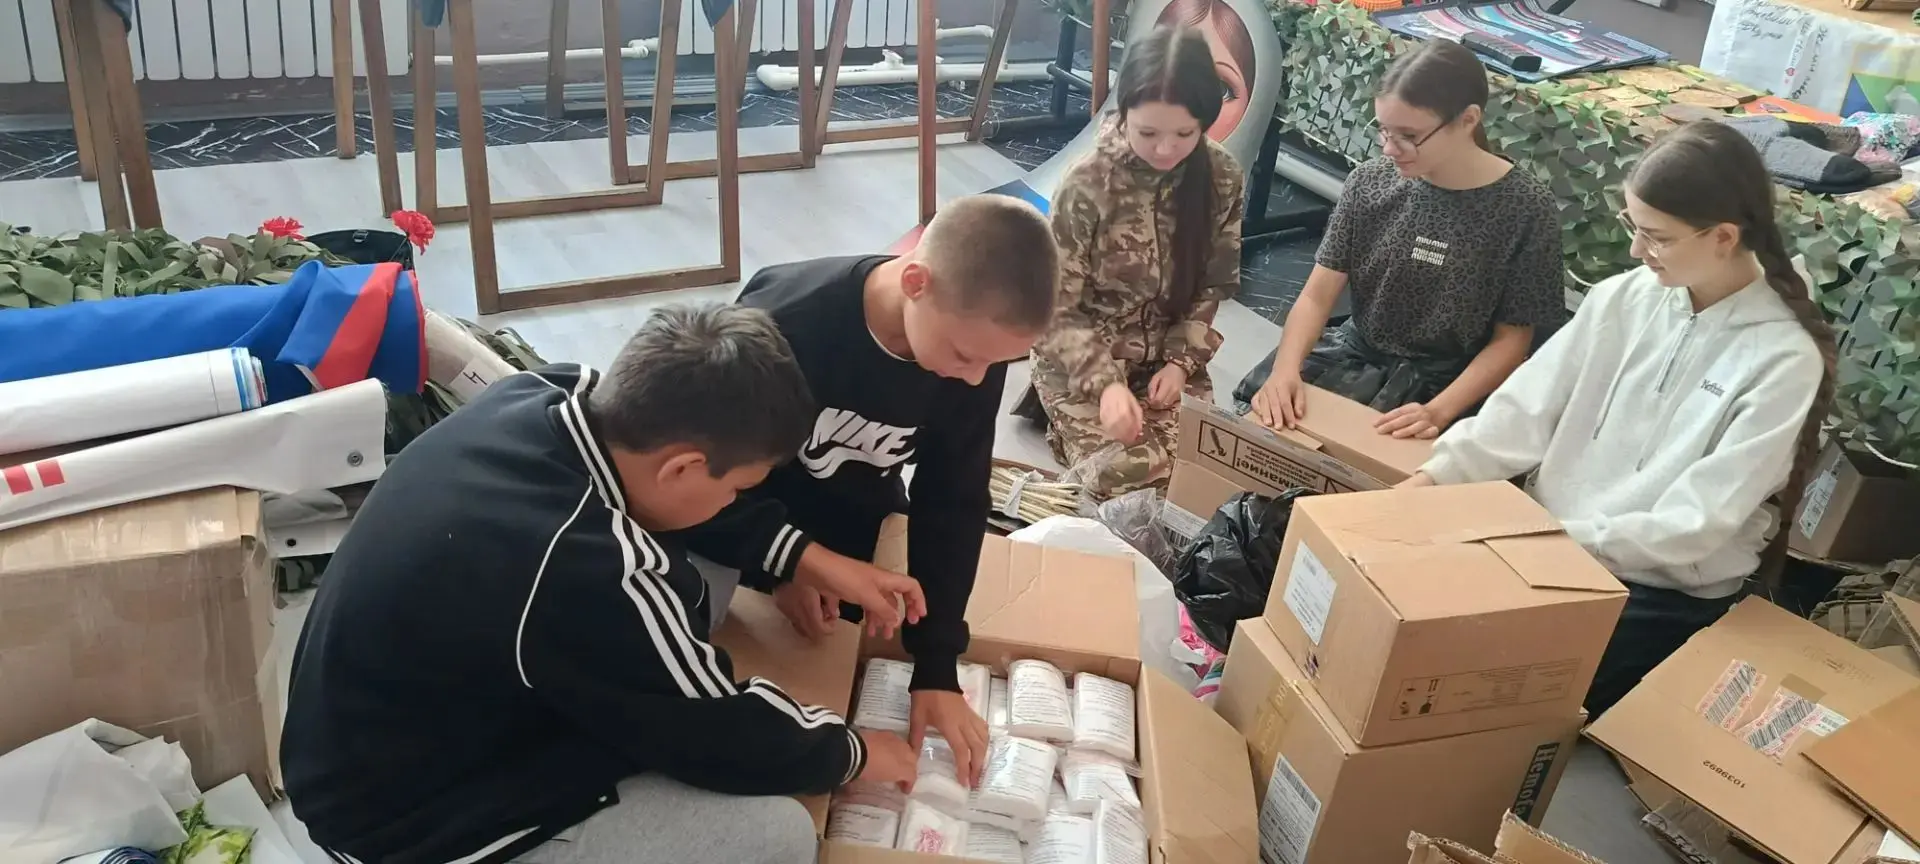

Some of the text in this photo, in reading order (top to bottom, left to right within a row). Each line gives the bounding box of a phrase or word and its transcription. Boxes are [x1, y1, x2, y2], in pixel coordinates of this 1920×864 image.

[808, 407, 917, 457] NIKE
[1236, 457, 1299, 490] имание!
[1514, 746, 1558, 816] Hemofa
